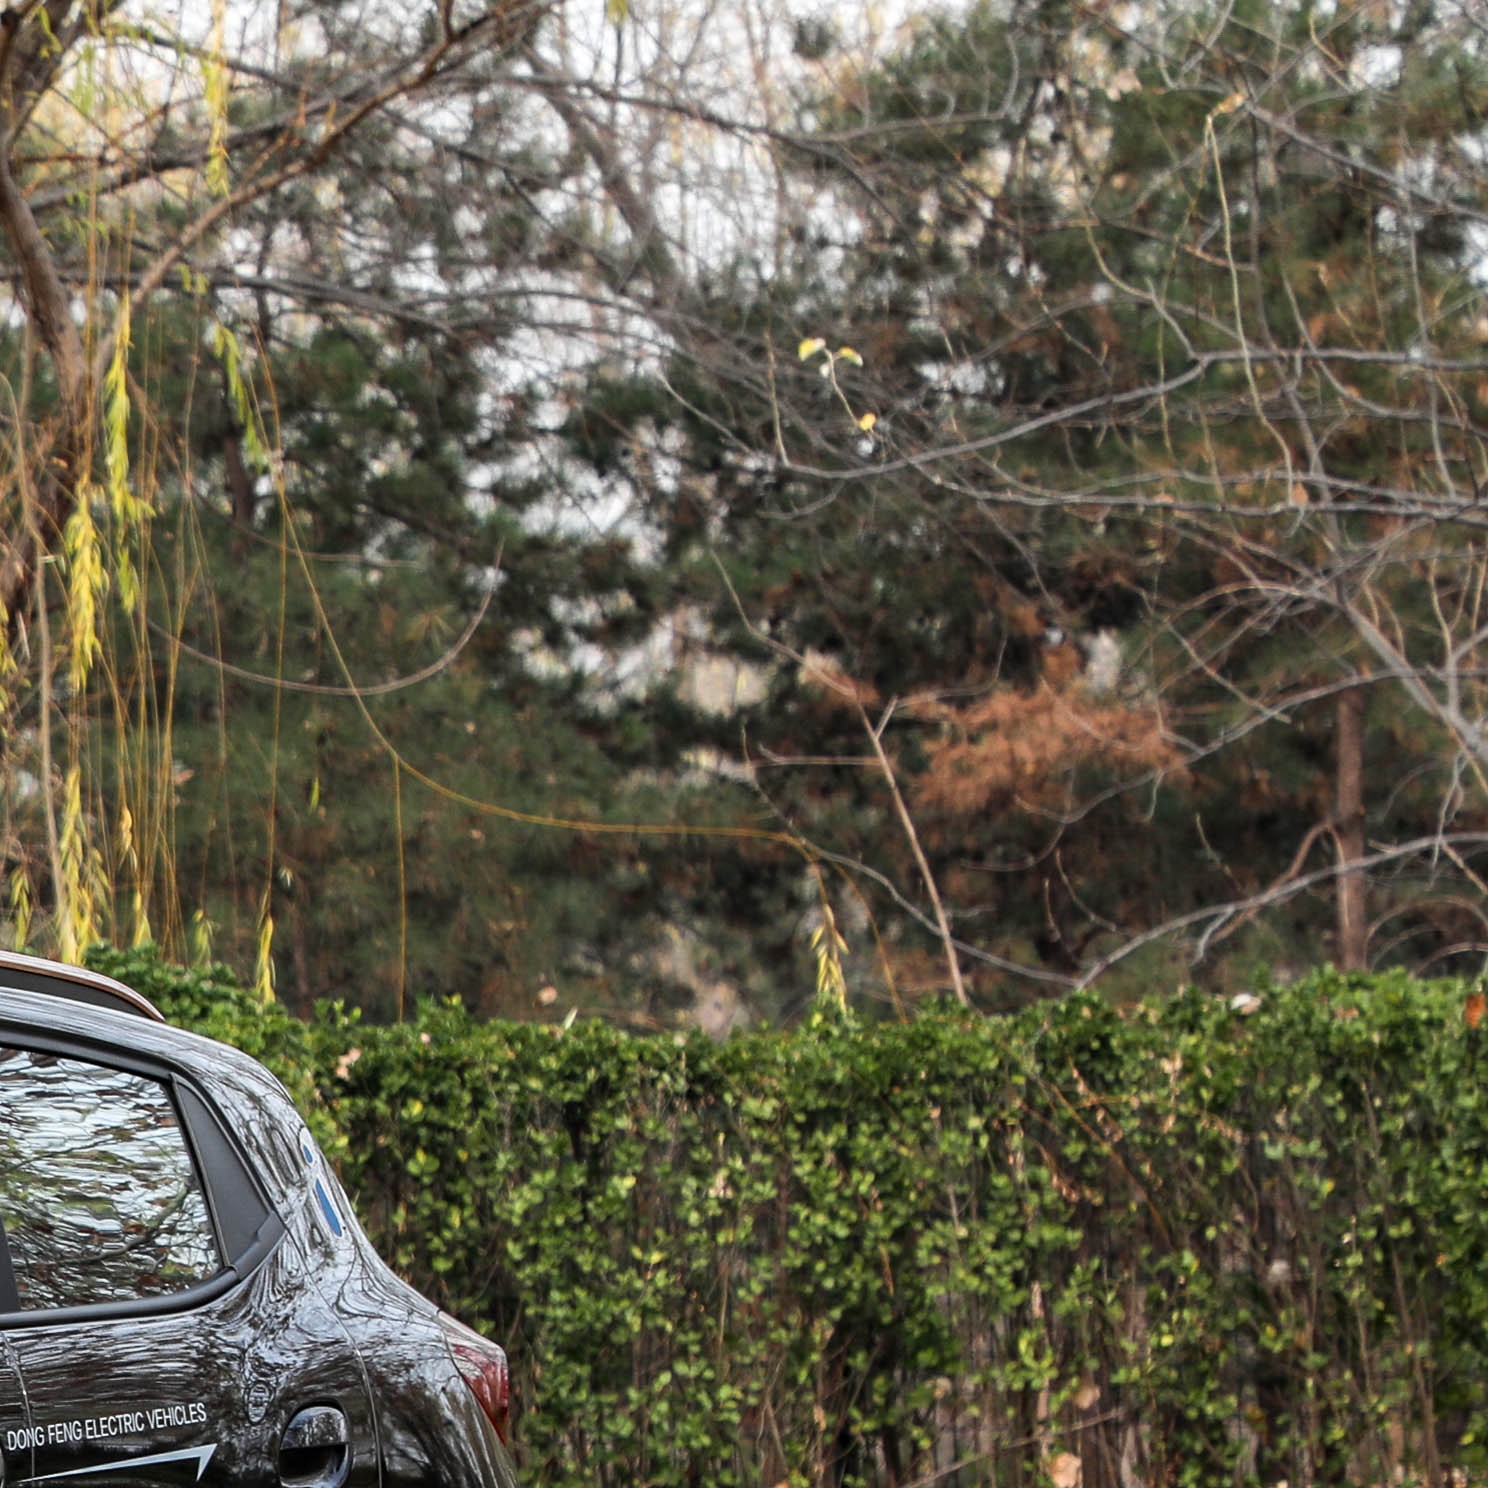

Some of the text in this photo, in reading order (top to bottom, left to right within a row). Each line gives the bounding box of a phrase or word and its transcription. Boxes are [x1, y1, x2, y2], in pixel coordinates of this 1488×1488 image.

[7, 1402, 207, 1450] DONG FENG ELECTRIC VEHICLES
